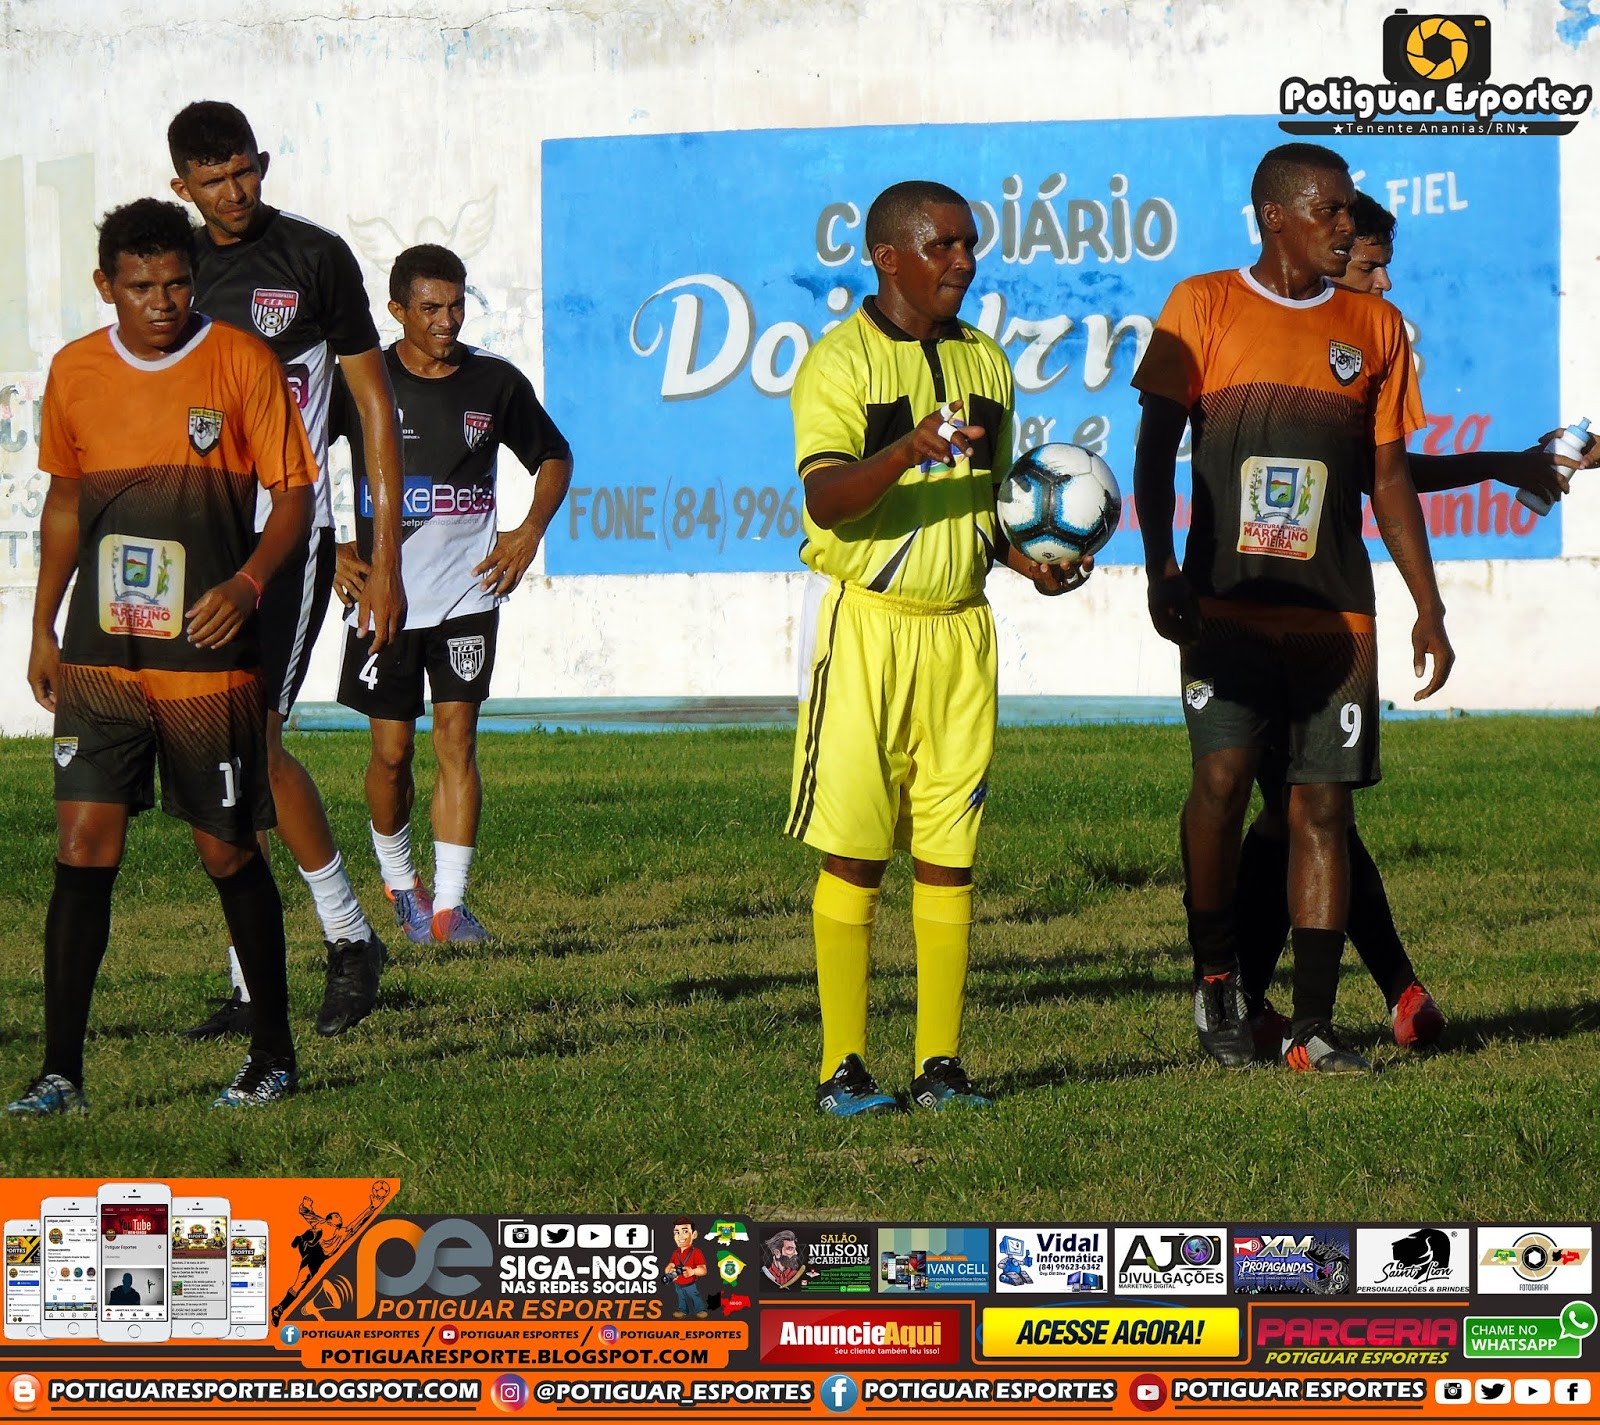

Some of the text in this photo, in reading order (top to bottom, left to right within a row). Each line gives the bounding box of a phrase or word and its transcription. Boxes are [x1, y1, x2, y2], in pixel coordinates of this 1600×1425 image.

[1385, 171, 1469, 218] FIEL
[569, 485, 656, 541] FONE
[663, 474, 728, 555] (84)
[1243, 527, 1309, 542] MARCELINO
[1258, 537, 1292, 549] VIEIRA
[359, 652, 379, 690] 4
[1340, 702, 1362, 748] 9
